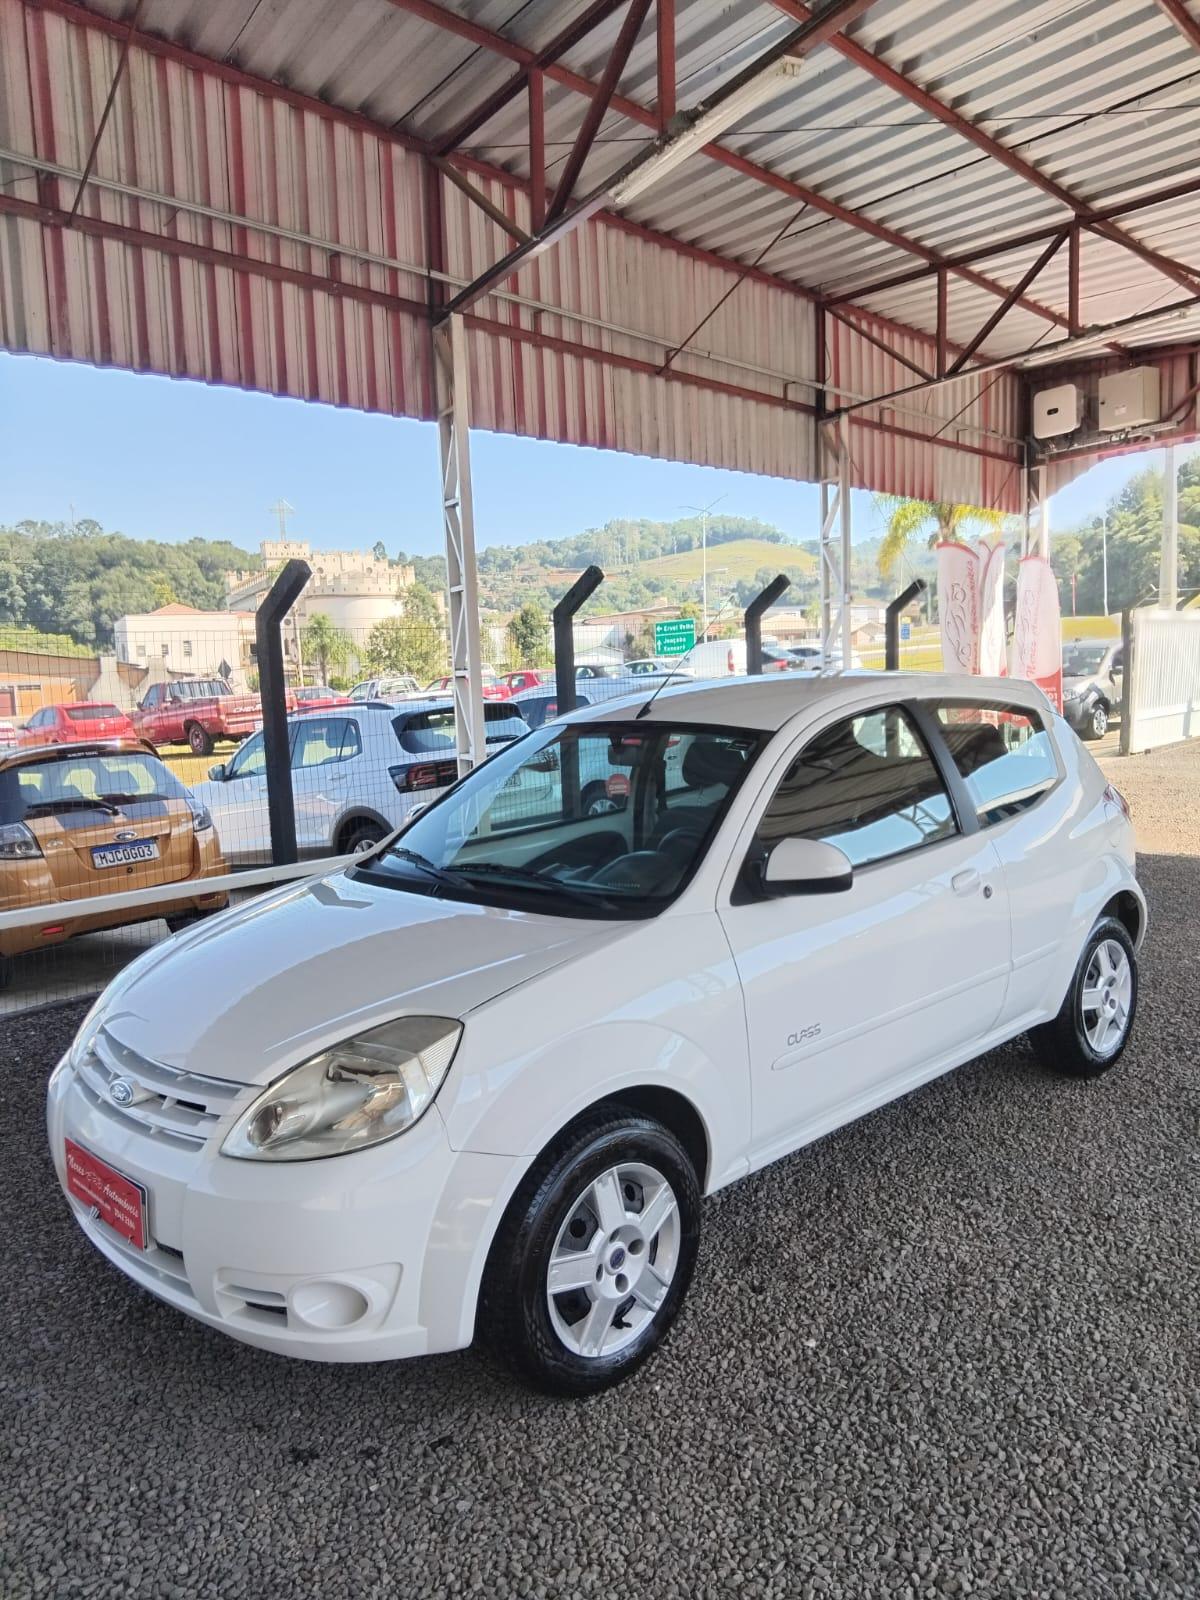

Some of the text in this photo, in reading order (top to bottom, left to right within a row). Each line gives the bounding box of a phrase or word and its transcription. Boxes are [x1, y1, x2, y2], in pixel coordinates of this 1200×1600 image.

[663, 624, 678, 632] Erval
[663, 637, 686, 645] Joaçaba
[787, 1023, 821, 1046] CLASS
